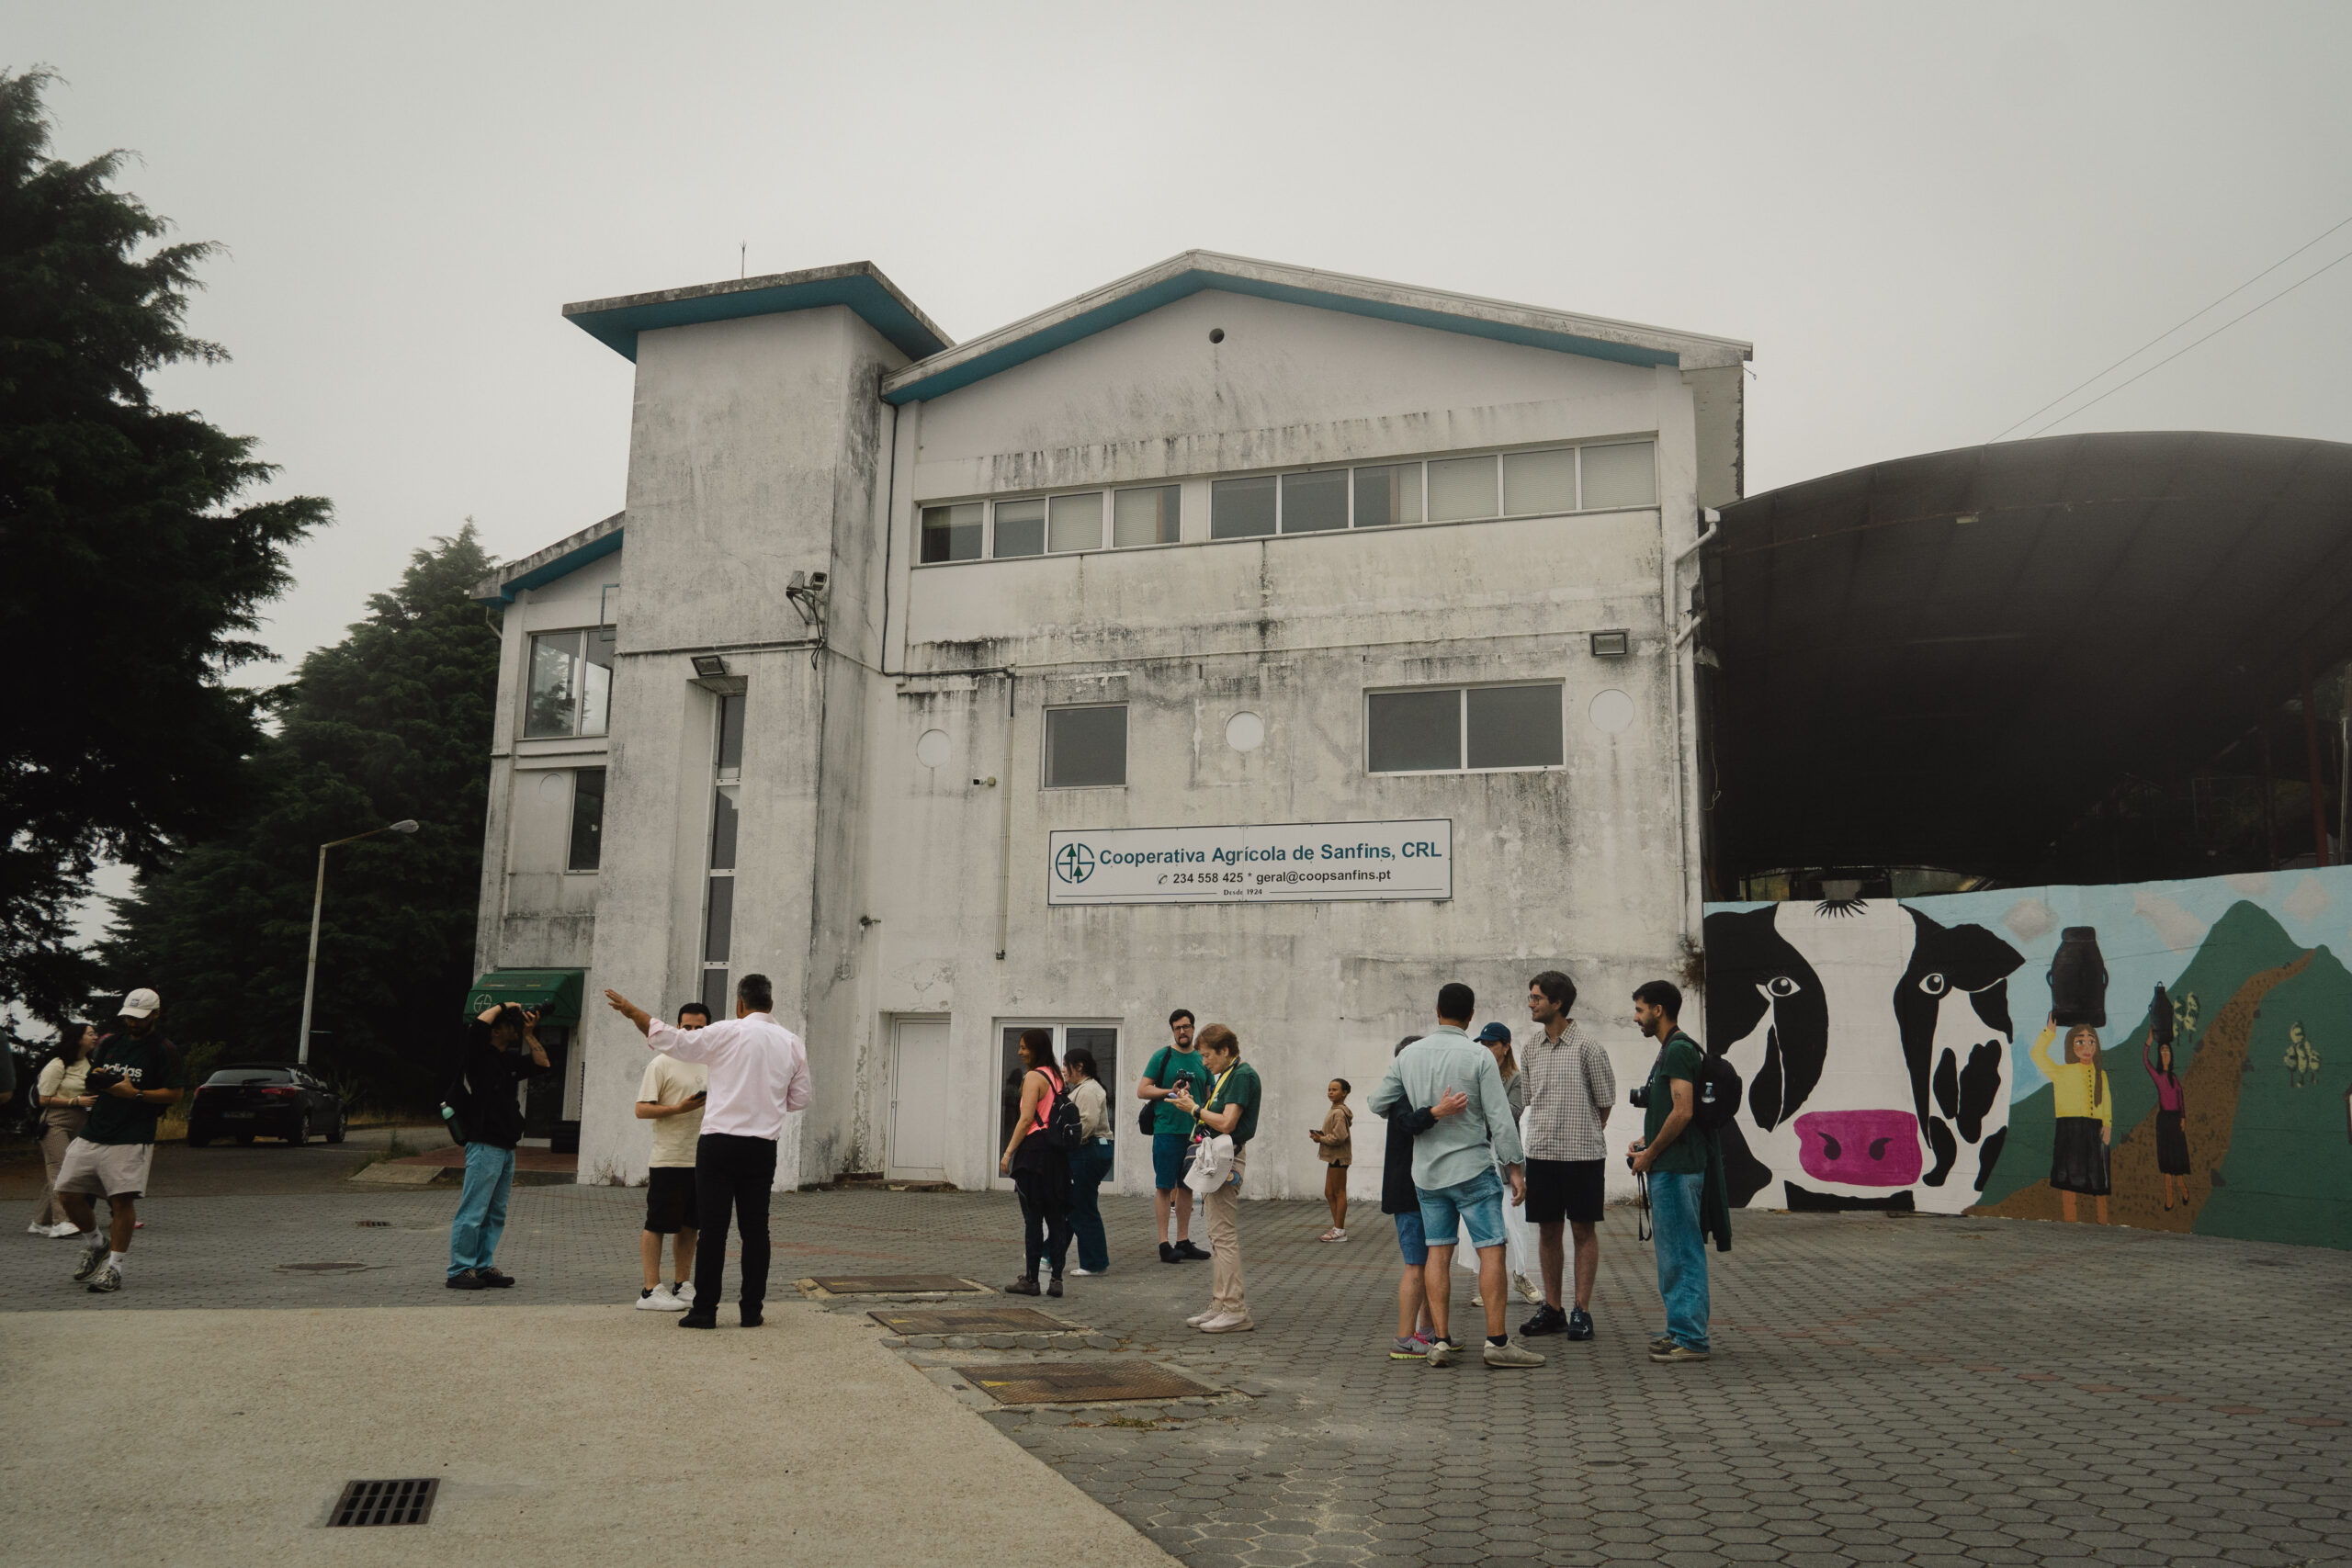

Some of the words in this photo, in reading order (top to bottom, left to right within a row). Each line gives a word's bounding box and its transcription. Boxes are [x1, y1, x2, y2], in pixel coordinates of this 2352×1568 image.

[1099, 847, 1205, 868] Cooperativa
[1211, 845, 1286, 866] Agrícola
[1292, 844, 1315, 861] de
[1320, 842, 1396, 862] Sanfins,
[1401, 841, 1442, 858] CRL
[1172, 873, 1194, 885] 234
[1197, 873, 1219, 884] 558
[1222, 872, 1244, 884] 425
[1256, 869, 1392, 886] geral@coopsanfins.pt
[1223, 888, 1244, 897] Desde
[1246, 888, 1263, 897] 1924
